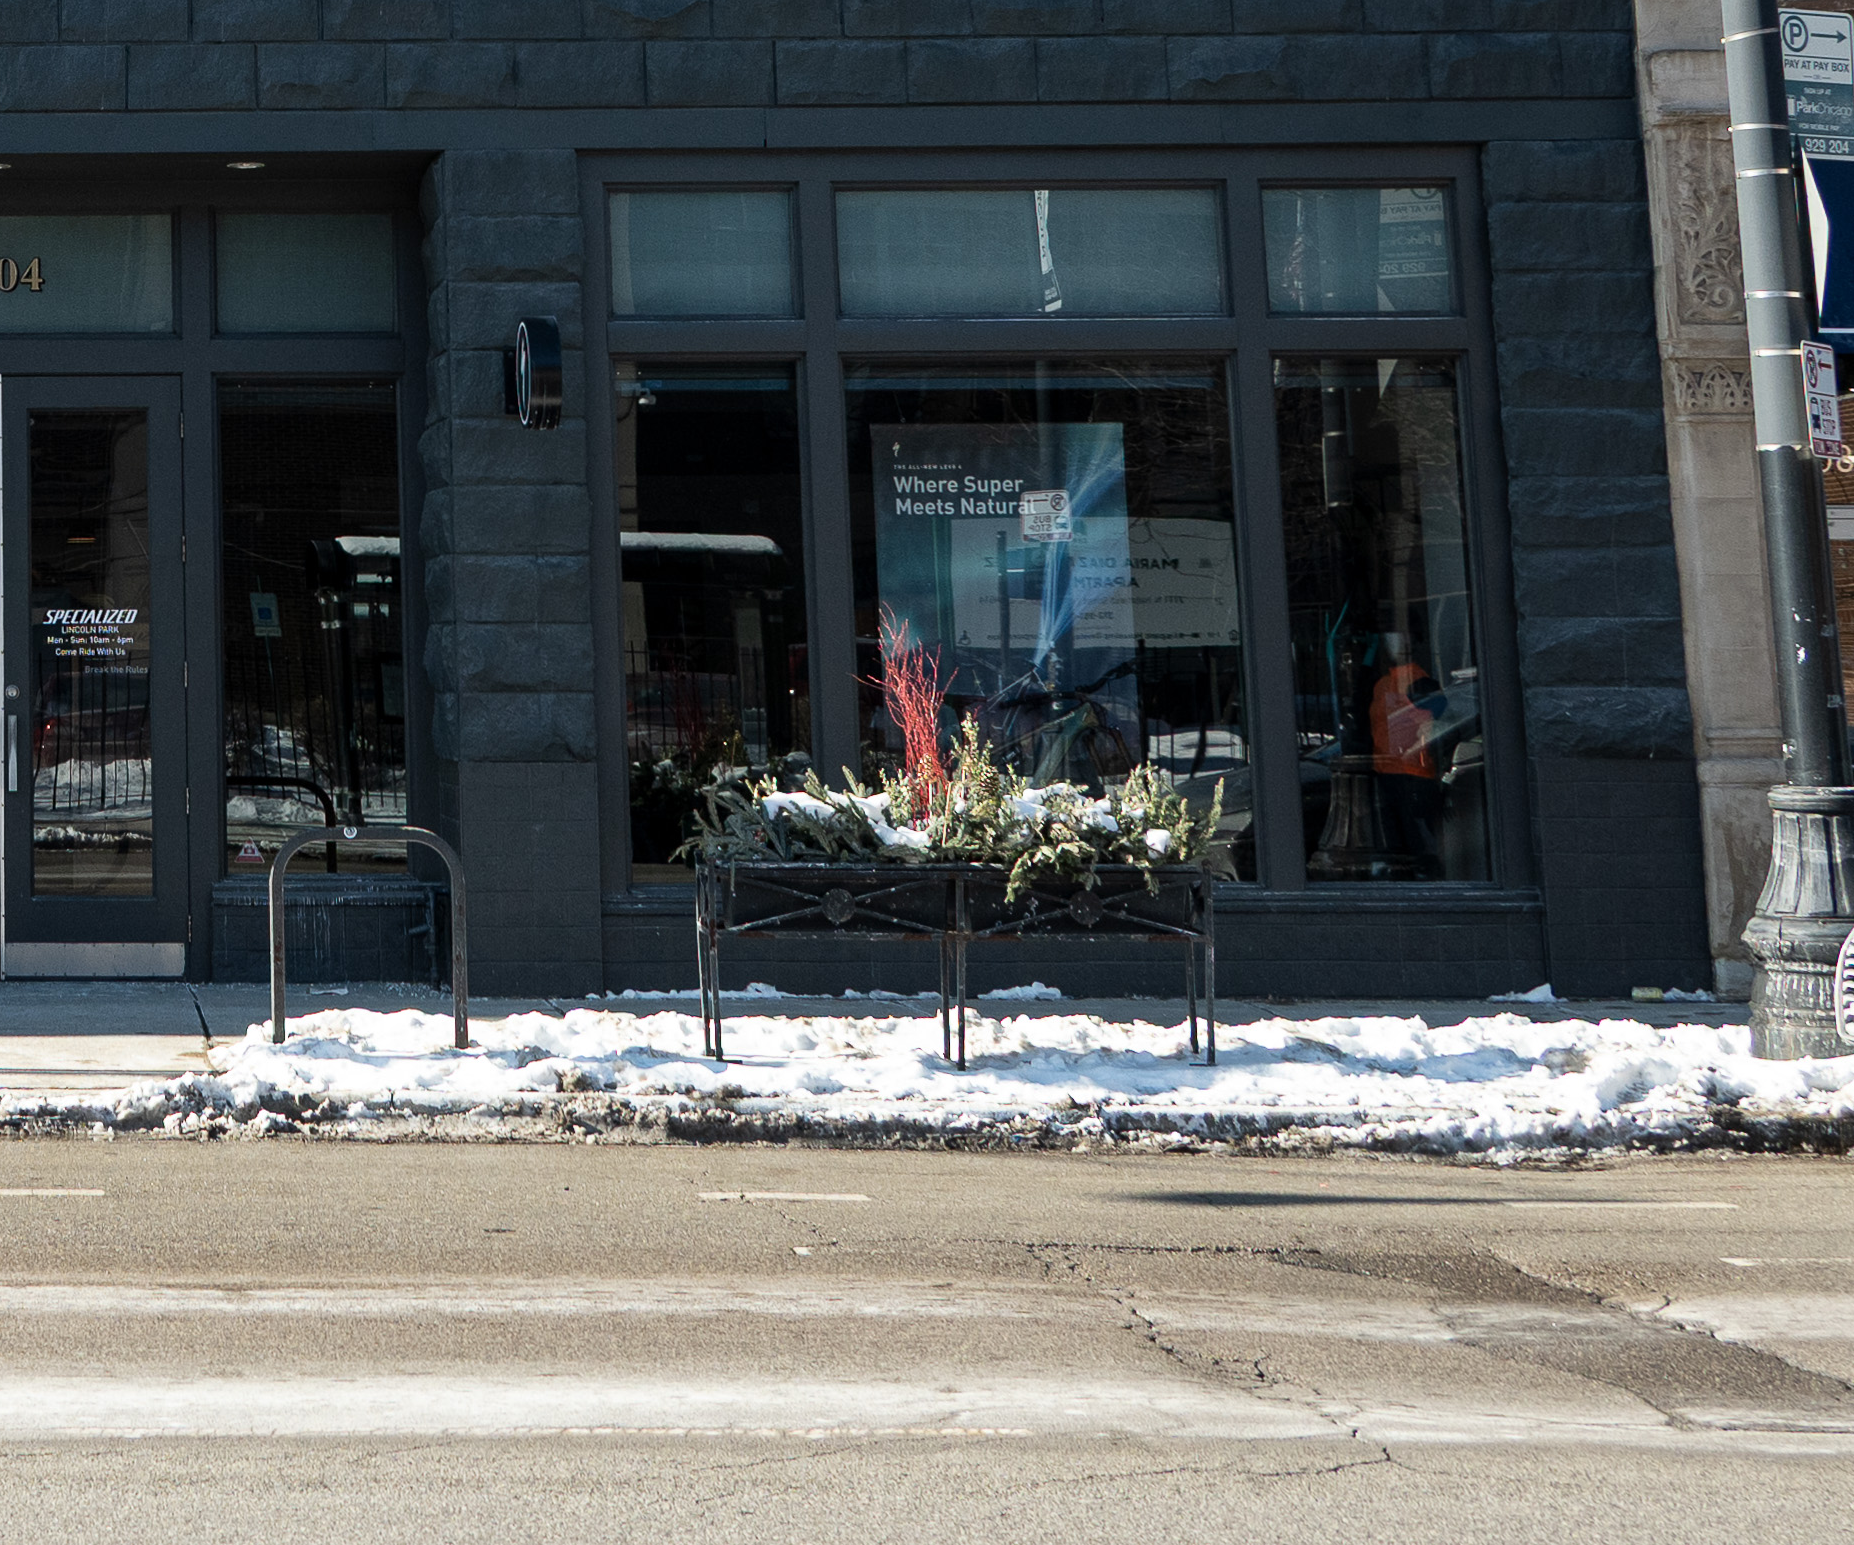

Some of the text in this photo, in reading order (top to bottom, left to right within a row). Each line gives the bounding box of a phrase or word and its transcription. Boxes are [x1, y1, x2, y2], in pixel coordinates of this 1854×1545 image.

[1784, 58, 1850, 73] PAY AT PAY BOX
[1805, 138, 1849, 154] 929 204
[894, 475, 1024, 497] Where Super
[895, 496, 1036, 516] Meets Natural
[43, 609, 139, 625] SPECIALIZED
[61, 625, 120, 634] LINCOLN PARK
[47, 636, 64, 644] Mon
[89, 636, 110, 644] 10am
[116, 636, 134, 646] 6pm
[55, 647, 126, 656] Come Ride With Us
[84, 665, 149, 674] Break the Rules
